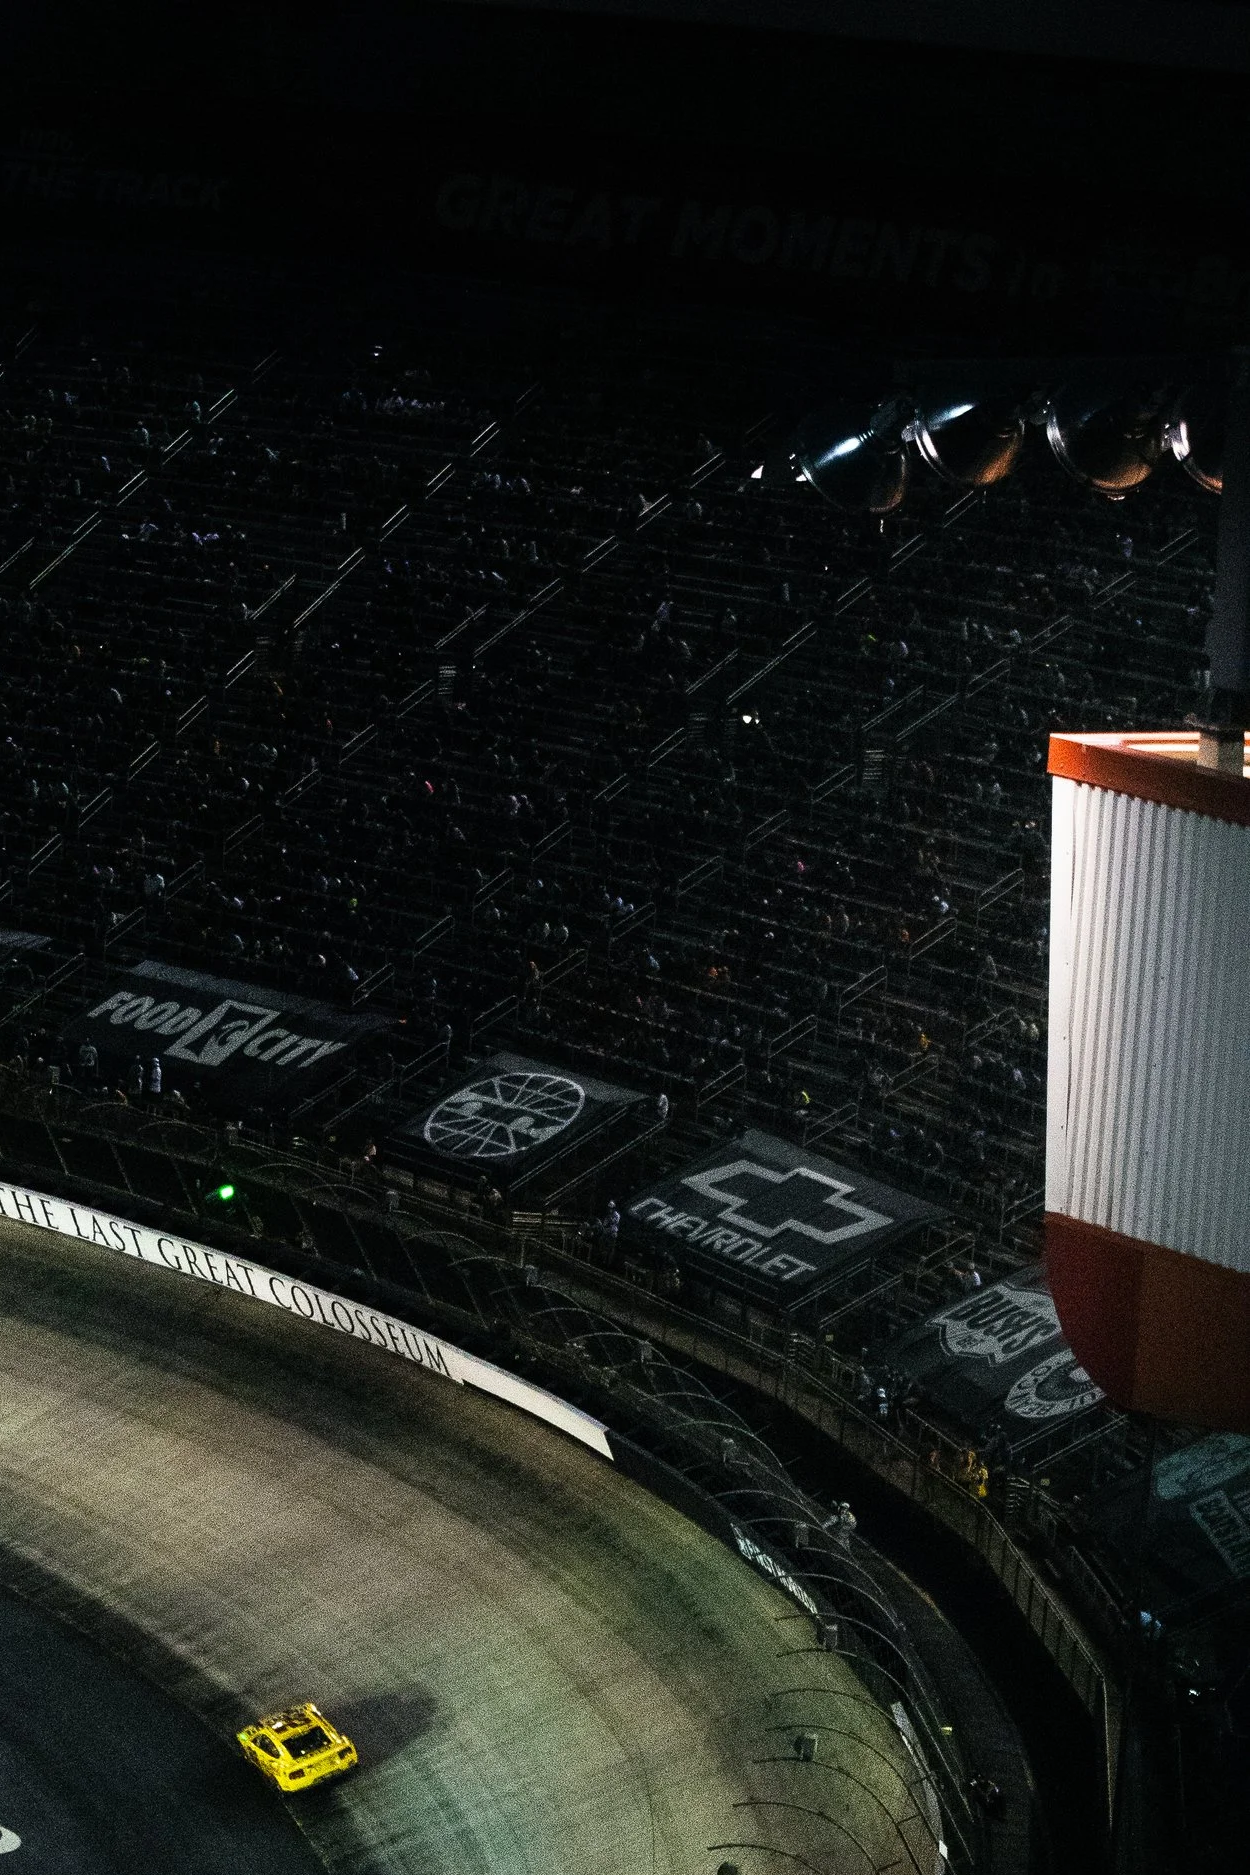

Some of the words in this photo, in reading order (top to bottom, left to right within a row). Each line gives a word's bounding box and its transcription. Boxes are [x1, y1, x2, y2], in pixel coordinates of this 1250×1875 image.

[1, 160, 86, 202] THE
[93, 167, 233, 212] TRACK
[433, 171, 666, 252] GREAT
[670, 198, 1002, 296] MOMENTS
[87, 990, 202, 1036] FOOD
[243, 1026, 350, 1069] CITY
[629, 1196, 817, 1282] CHEVROLET
[66, 1207, 145, 1258] LAST
[157, 1238, 258, 1297] GREAT
[268, 1276, 451, 1377] COLOSSEUM
